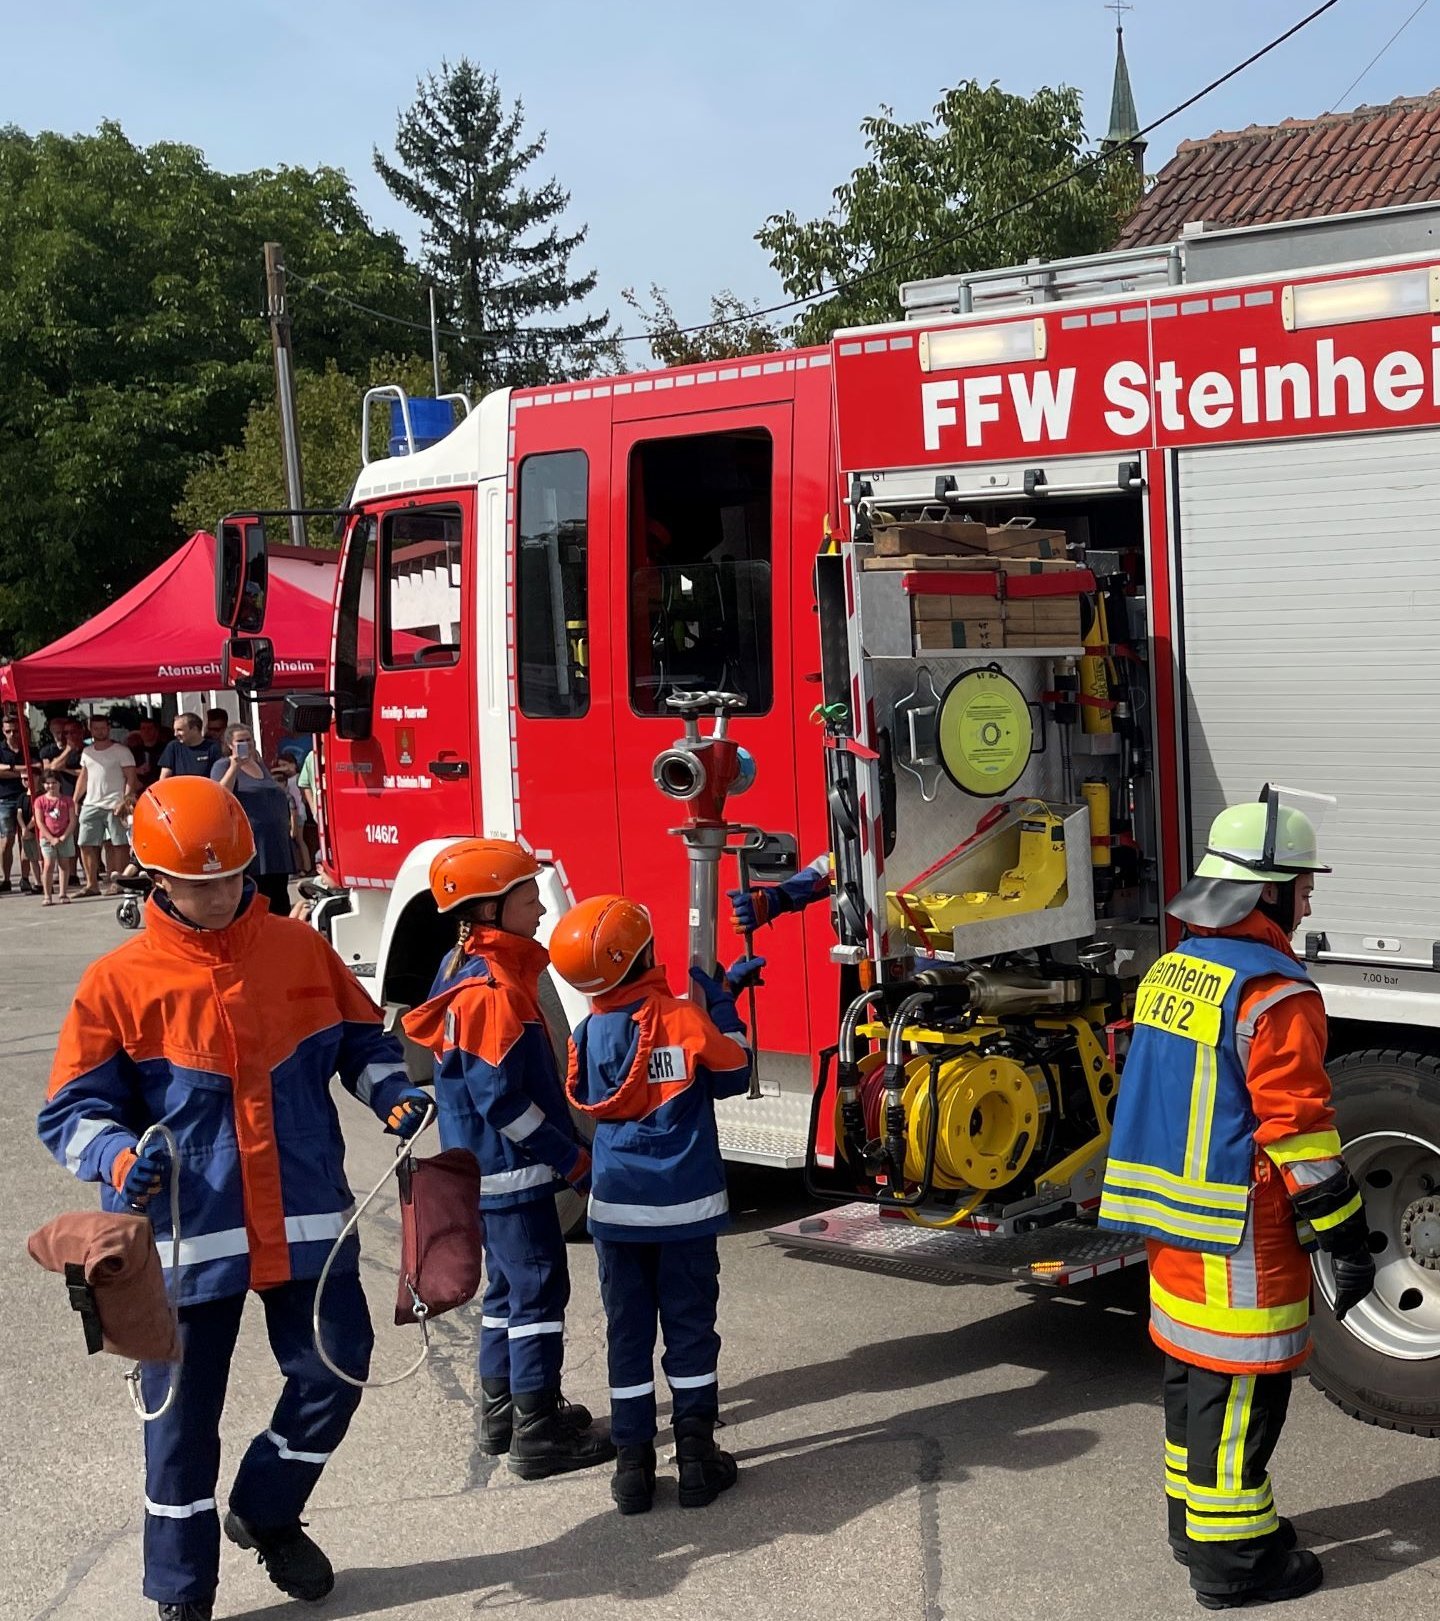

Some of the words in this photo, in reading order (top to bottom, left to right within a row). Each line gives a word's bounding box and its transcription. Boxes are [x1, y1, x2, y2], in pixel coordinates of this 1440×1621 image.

[921, 367, 1076, 450] FFW
[273, 660, 314, 671] nheim
[365, 824, 398, 844] 1/46/2
[1362, 973, 1382, 983] 7,00
[1384, 975, 1399, 984] bar
[1138, 990, 1195, 1031] 1/46/2
